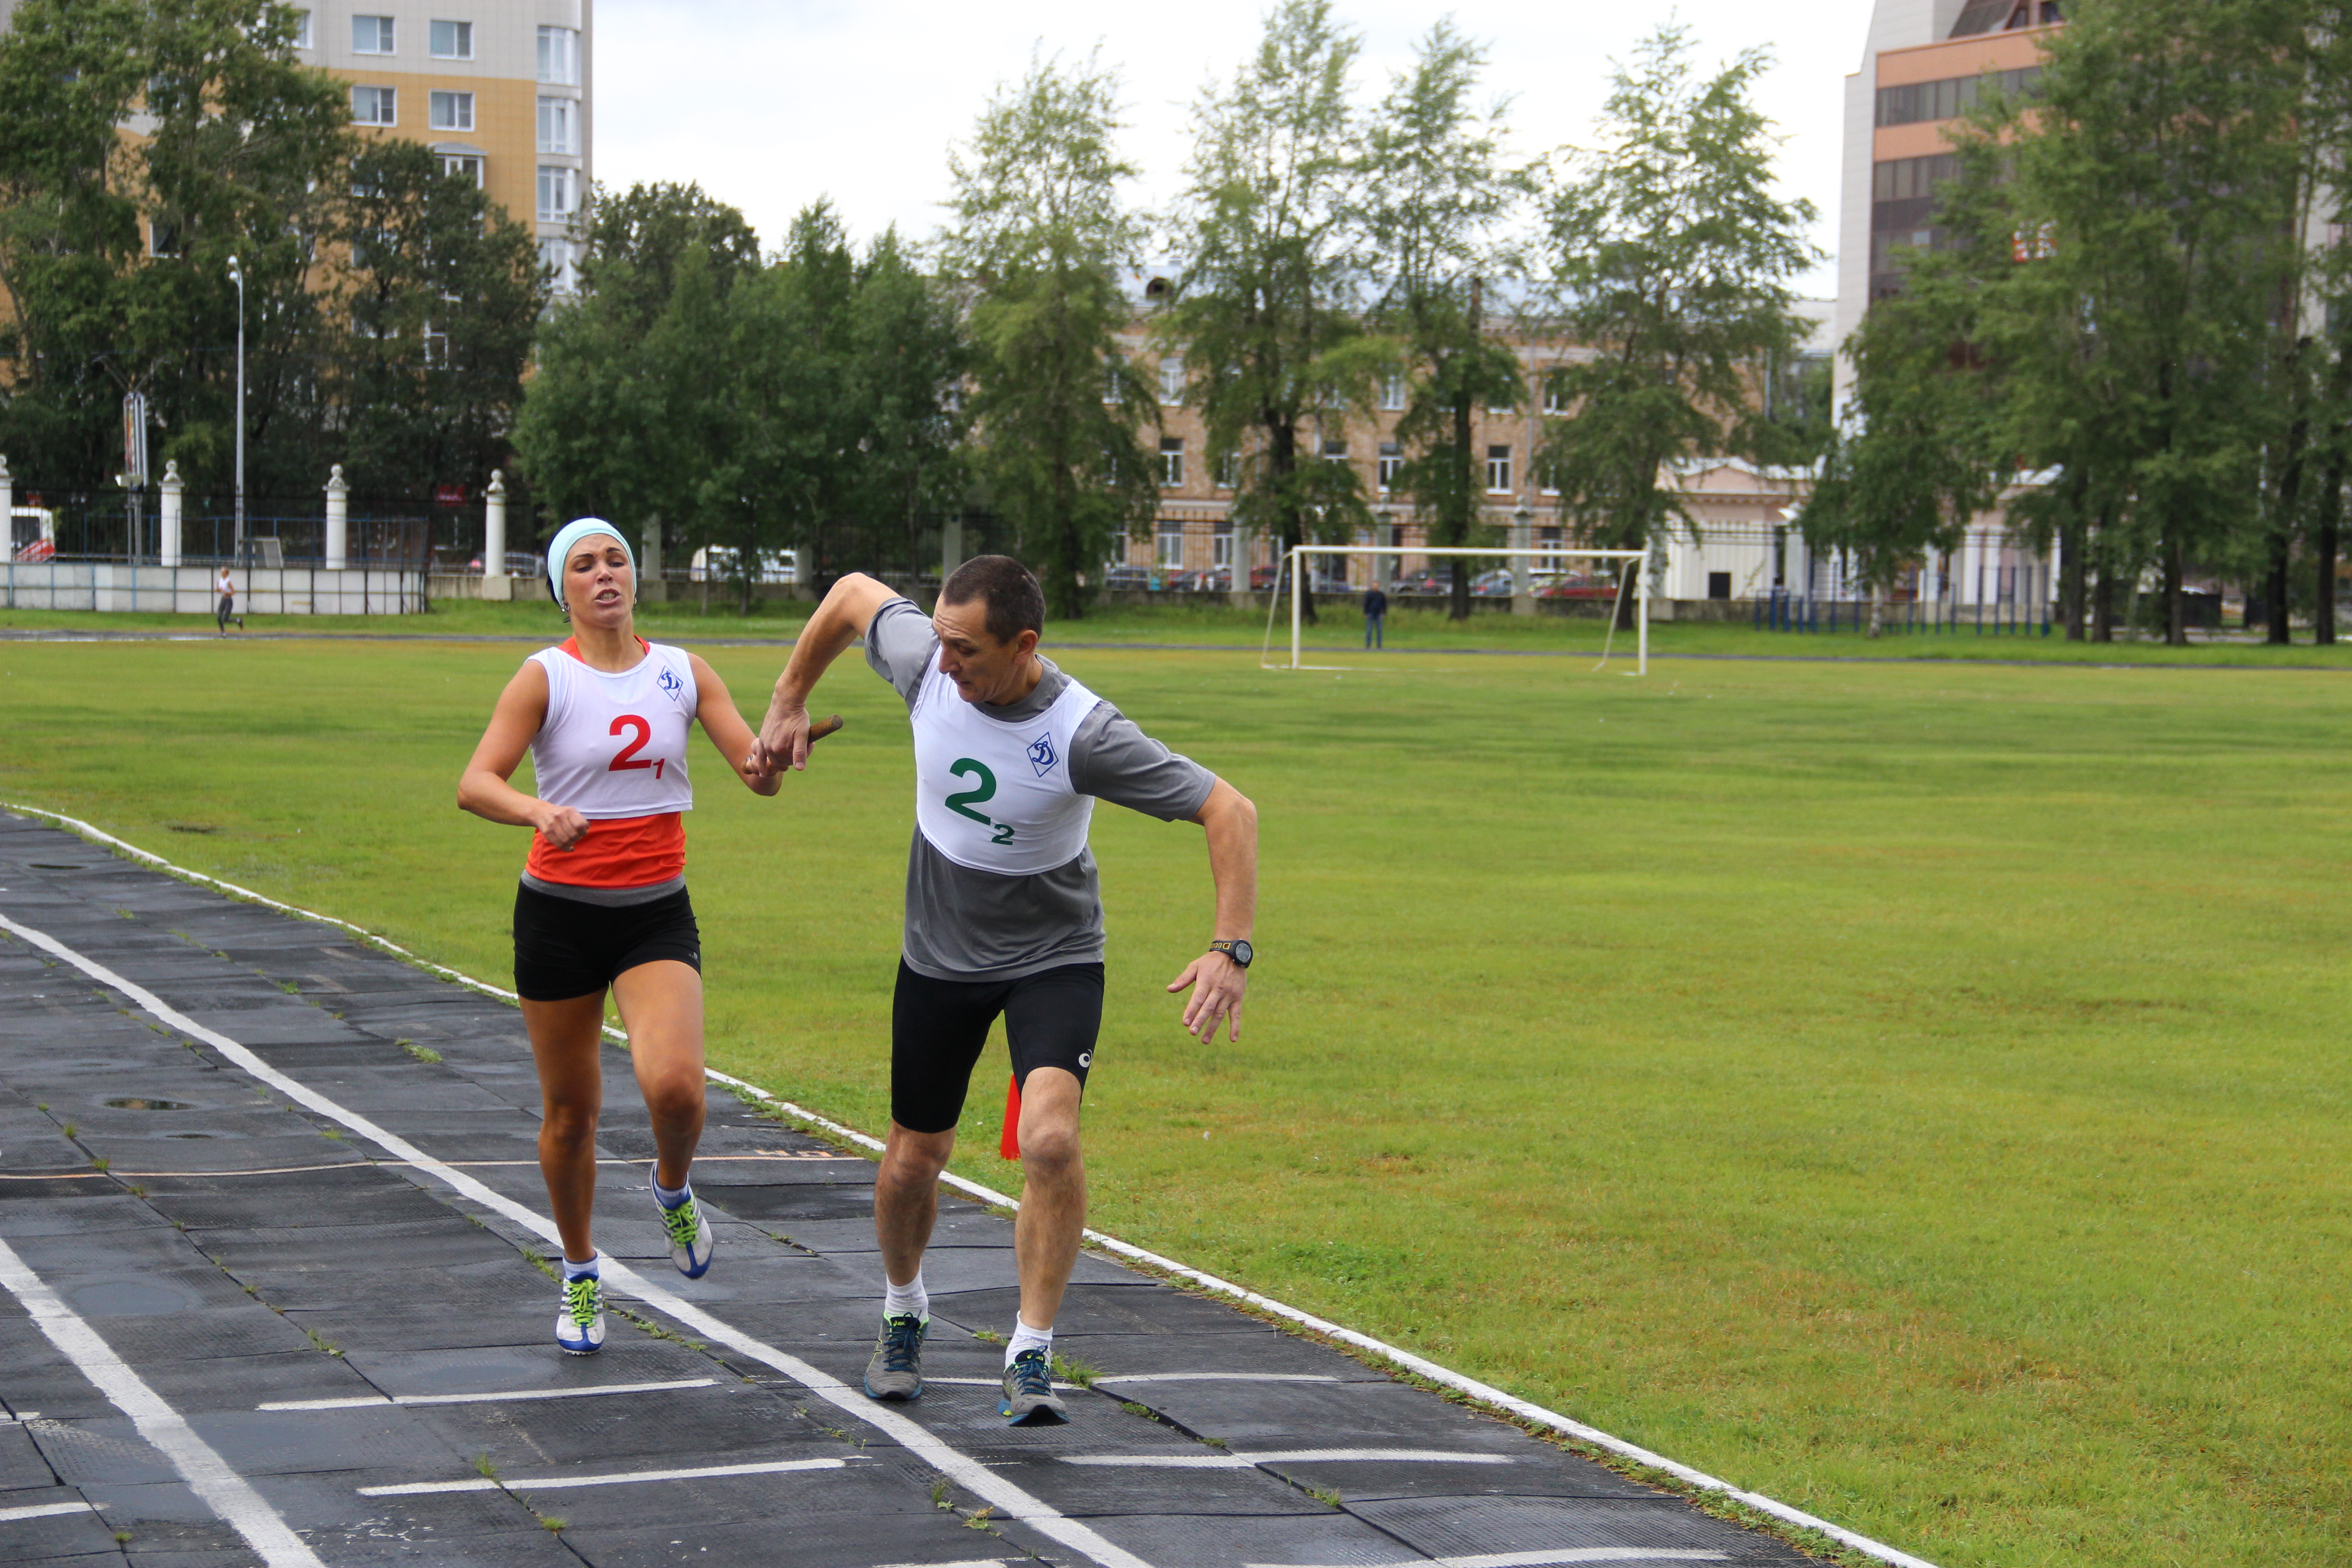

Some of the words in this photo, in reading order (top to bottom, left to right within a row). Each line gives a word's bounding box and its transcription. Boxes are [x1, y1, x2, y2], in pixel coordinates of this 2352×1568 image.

[608, 714, 652, 772] 2
[653, 758, 665, 779] 1
[945, 758, 997, 826] 2
[991, 824, 1015, 845] 2
